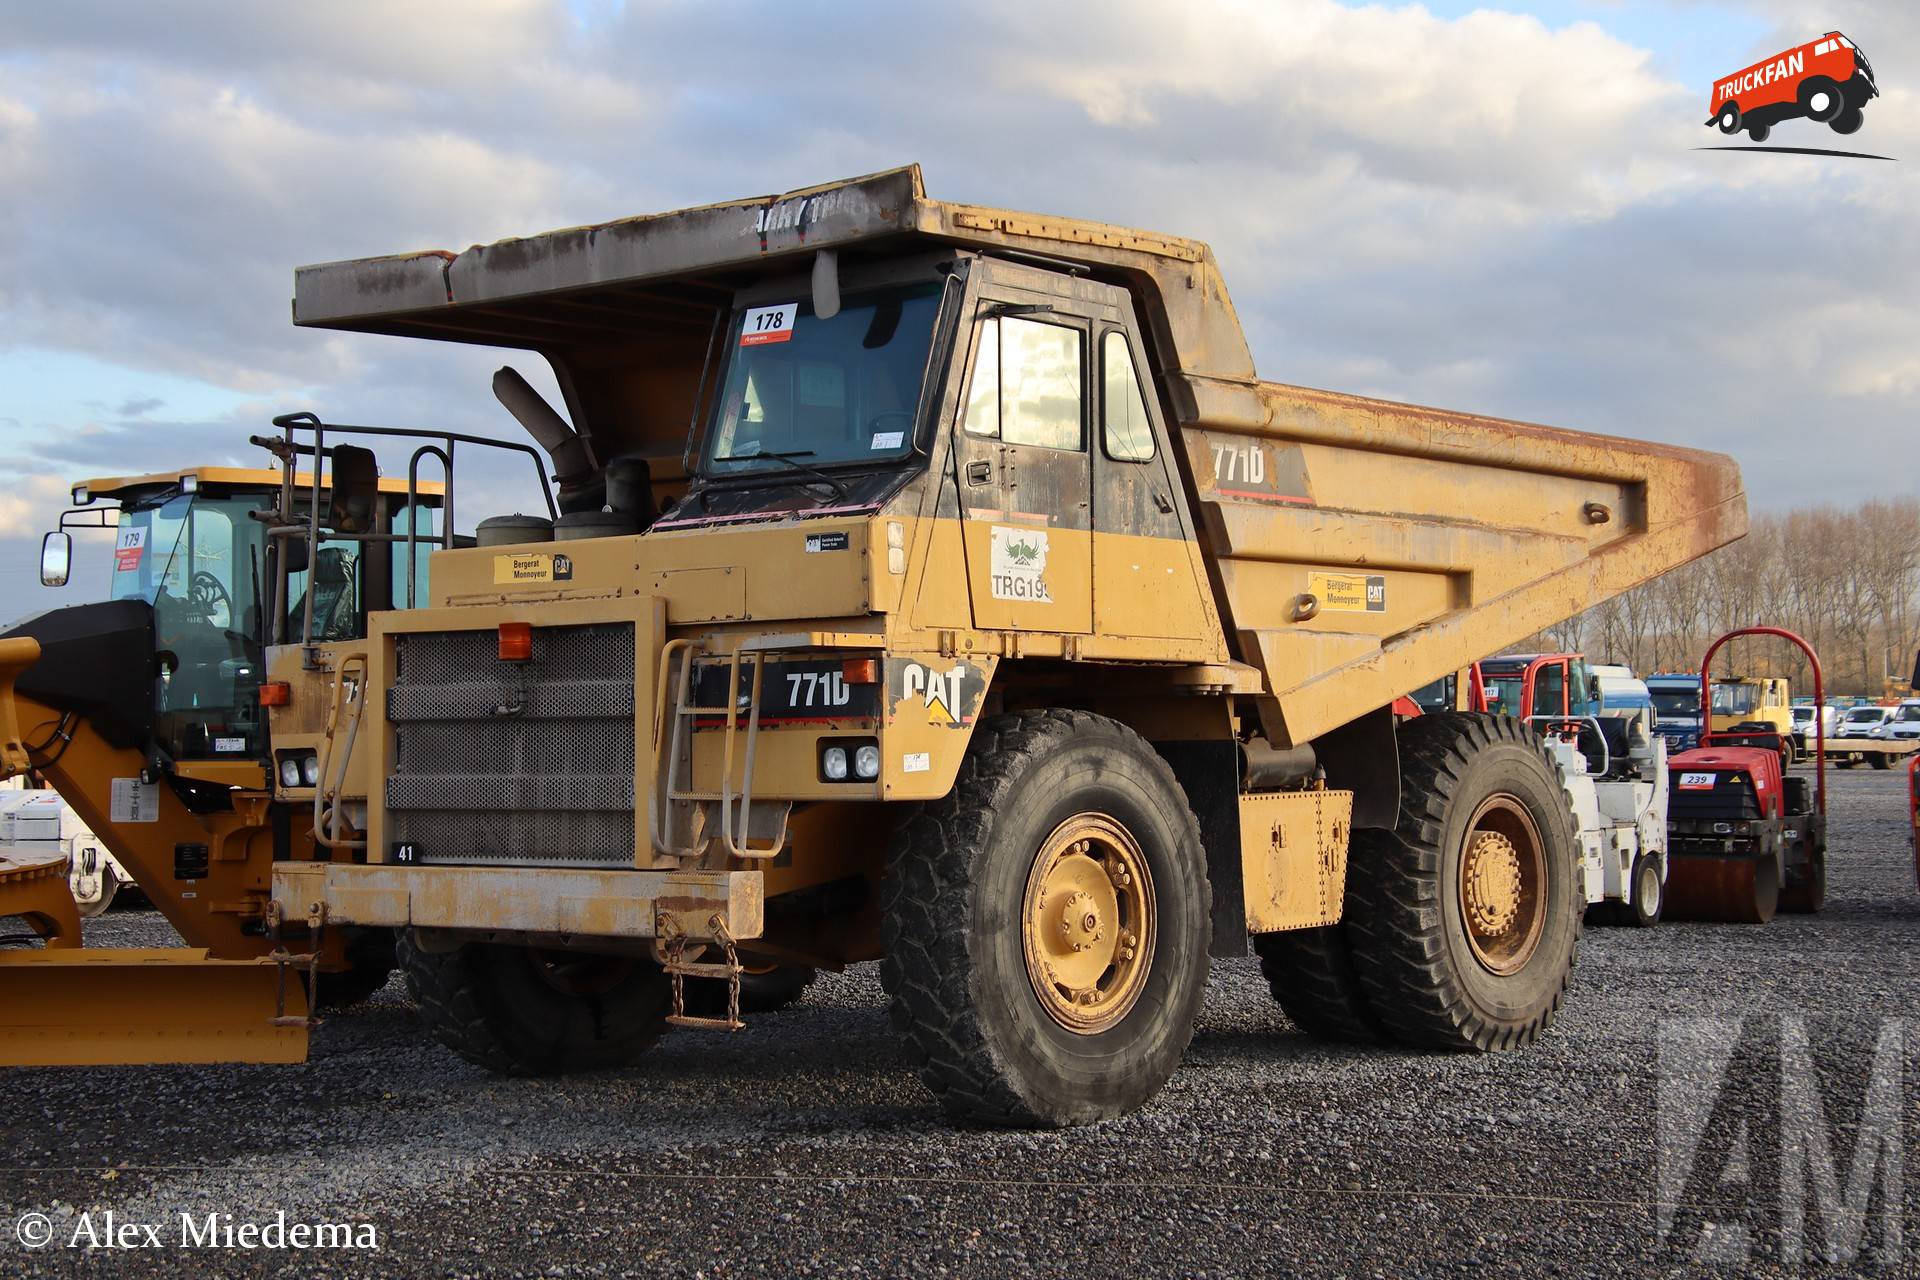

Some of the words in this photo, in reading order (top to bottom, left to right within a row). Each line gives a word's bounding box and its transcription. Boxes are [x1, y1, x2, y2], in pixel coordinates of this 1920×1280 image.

[756, 311, 784, 331] 178
[1211, 443, 1264, 484] 771D
[124, 532, 140, 547] 179
[513, 560, 540, 569] Bergerat
[555, 558, 570, 573] CAT
[513, 570, 547, 579] Monnoyeur
[1327, 580, 1353, 592] Bergerat
[1368, 585, 1384, 602] CAT
[787, 671, 850, 707] 771D
[903, 663, 965, 723] CAT
[1687, 775, 1707, 784] 239
[398, 845, 413, 861] 41
